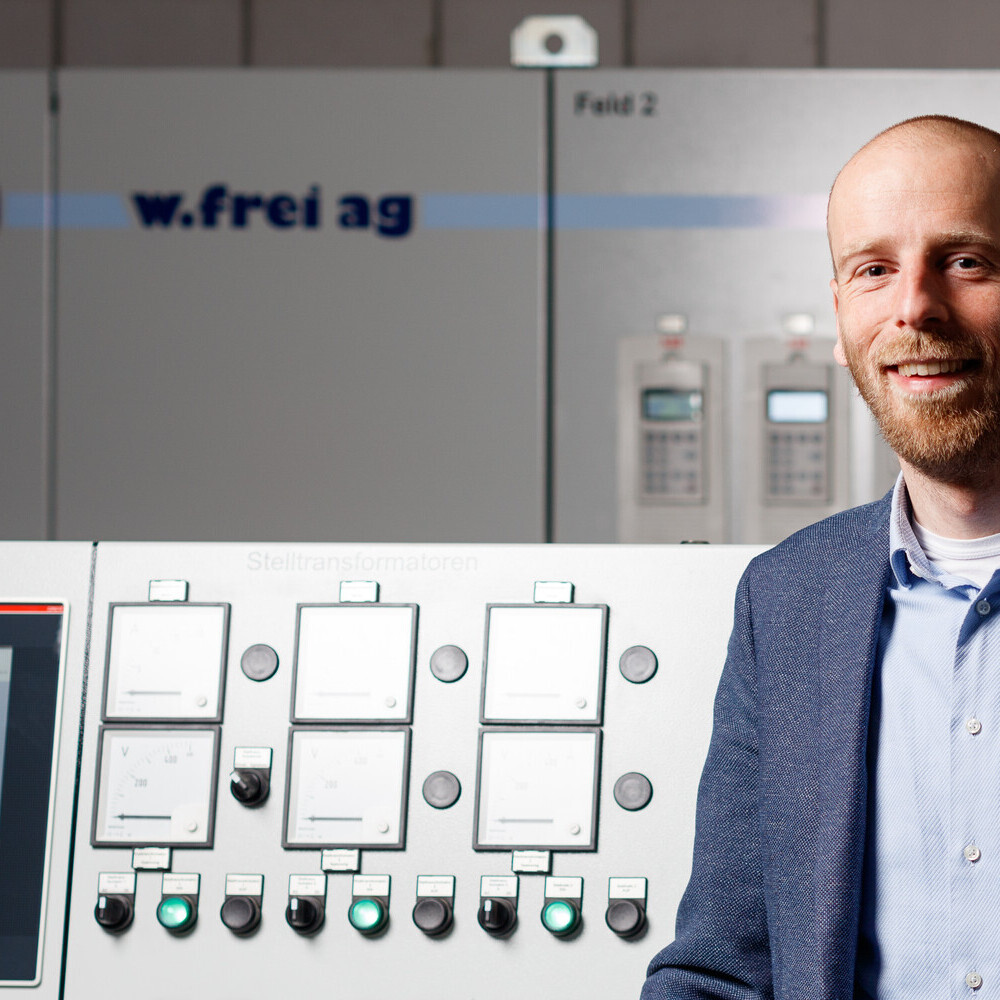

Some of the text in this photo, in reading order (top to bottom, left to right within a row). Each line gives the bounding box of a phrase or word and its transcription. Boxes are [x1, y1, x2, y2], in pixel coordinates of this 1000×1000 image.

[573, 90, 660, 117] Feld 2
[132, 181, 415, 239] w.frei ag
[246, 550, 479, 572] Stelltransformatoren
